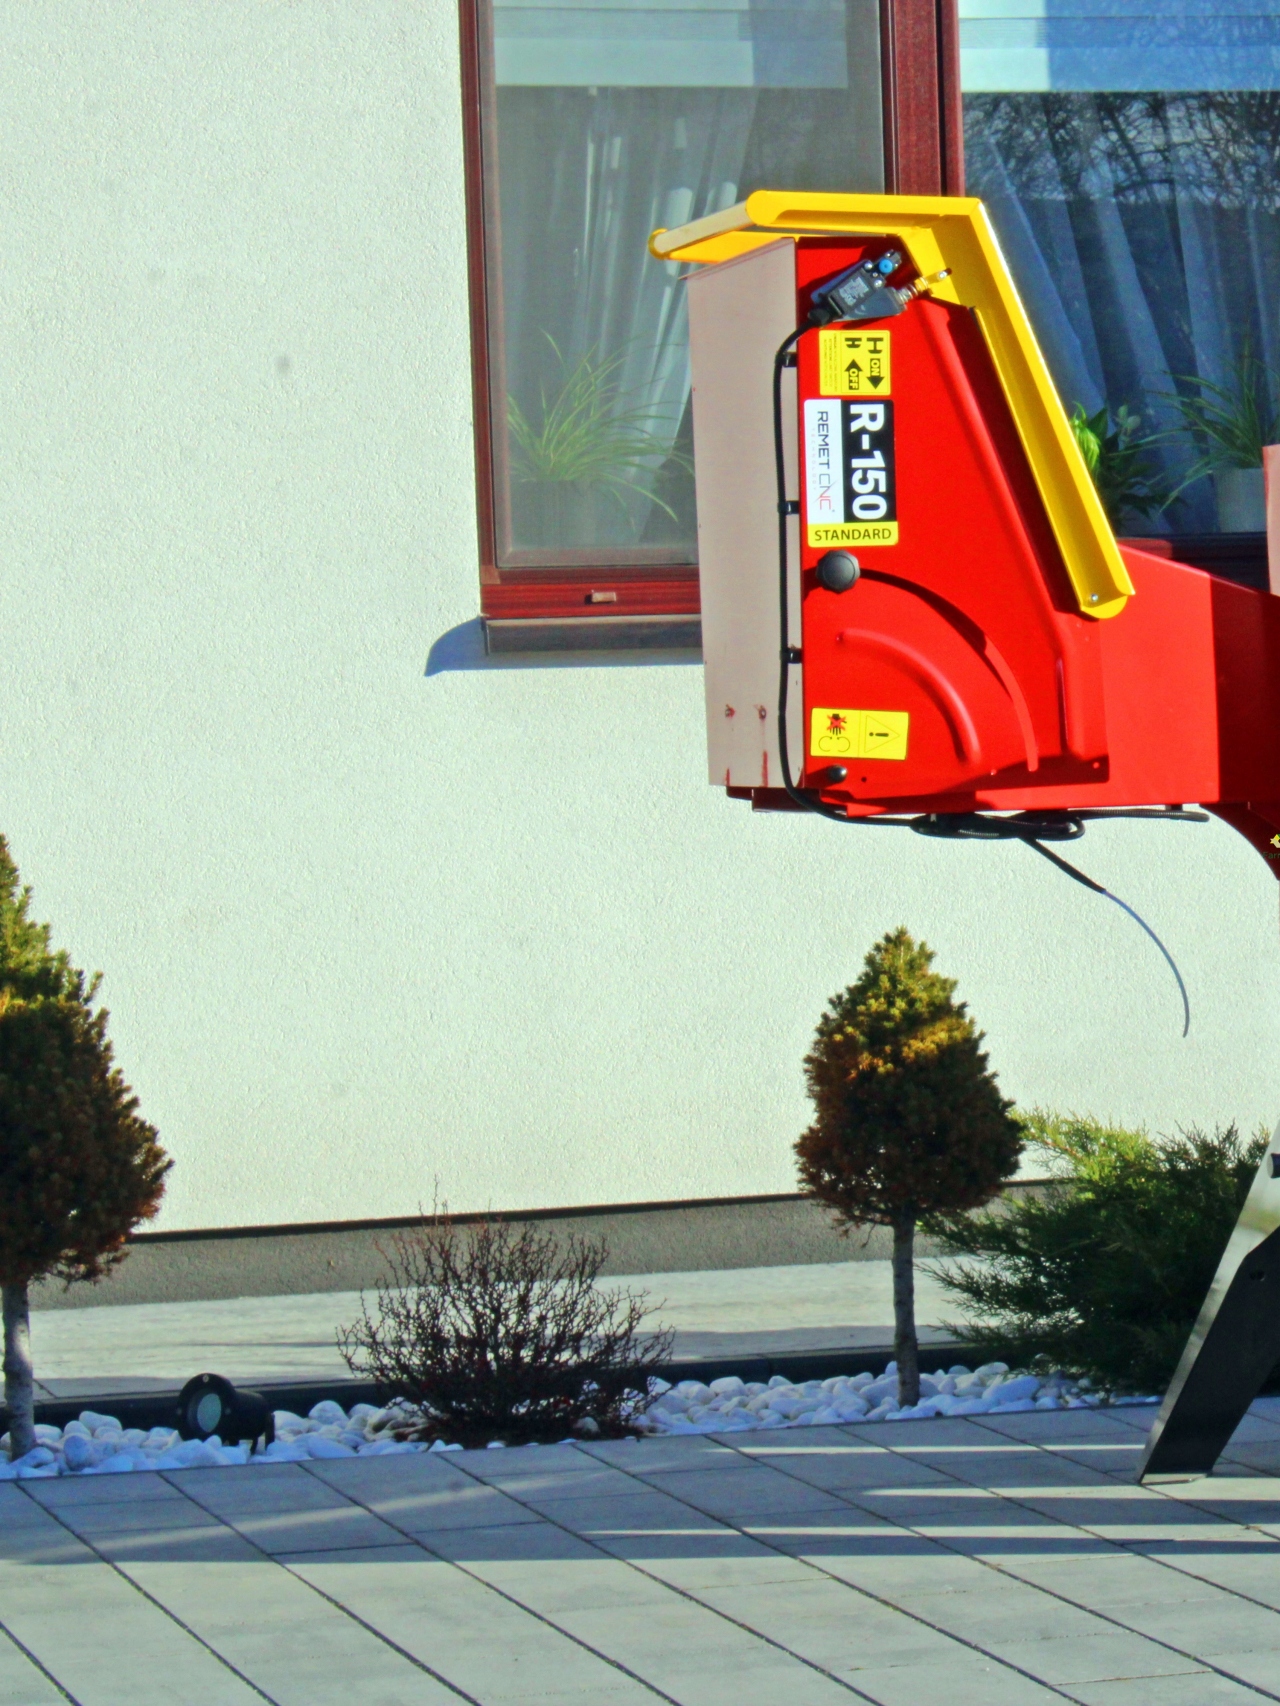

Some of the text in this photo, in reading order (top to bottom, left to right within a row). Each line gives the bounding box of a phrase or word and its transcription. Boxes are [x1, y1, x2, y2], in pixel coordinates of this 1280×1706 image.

[871, 359, 880, 376] ON
[849, 368, 859, 389] OFF
[817, 410, 832, 511] REMET CNC
[850, 403, 888, 520] R-150
[814, 527, 892, 542] STANDARD
